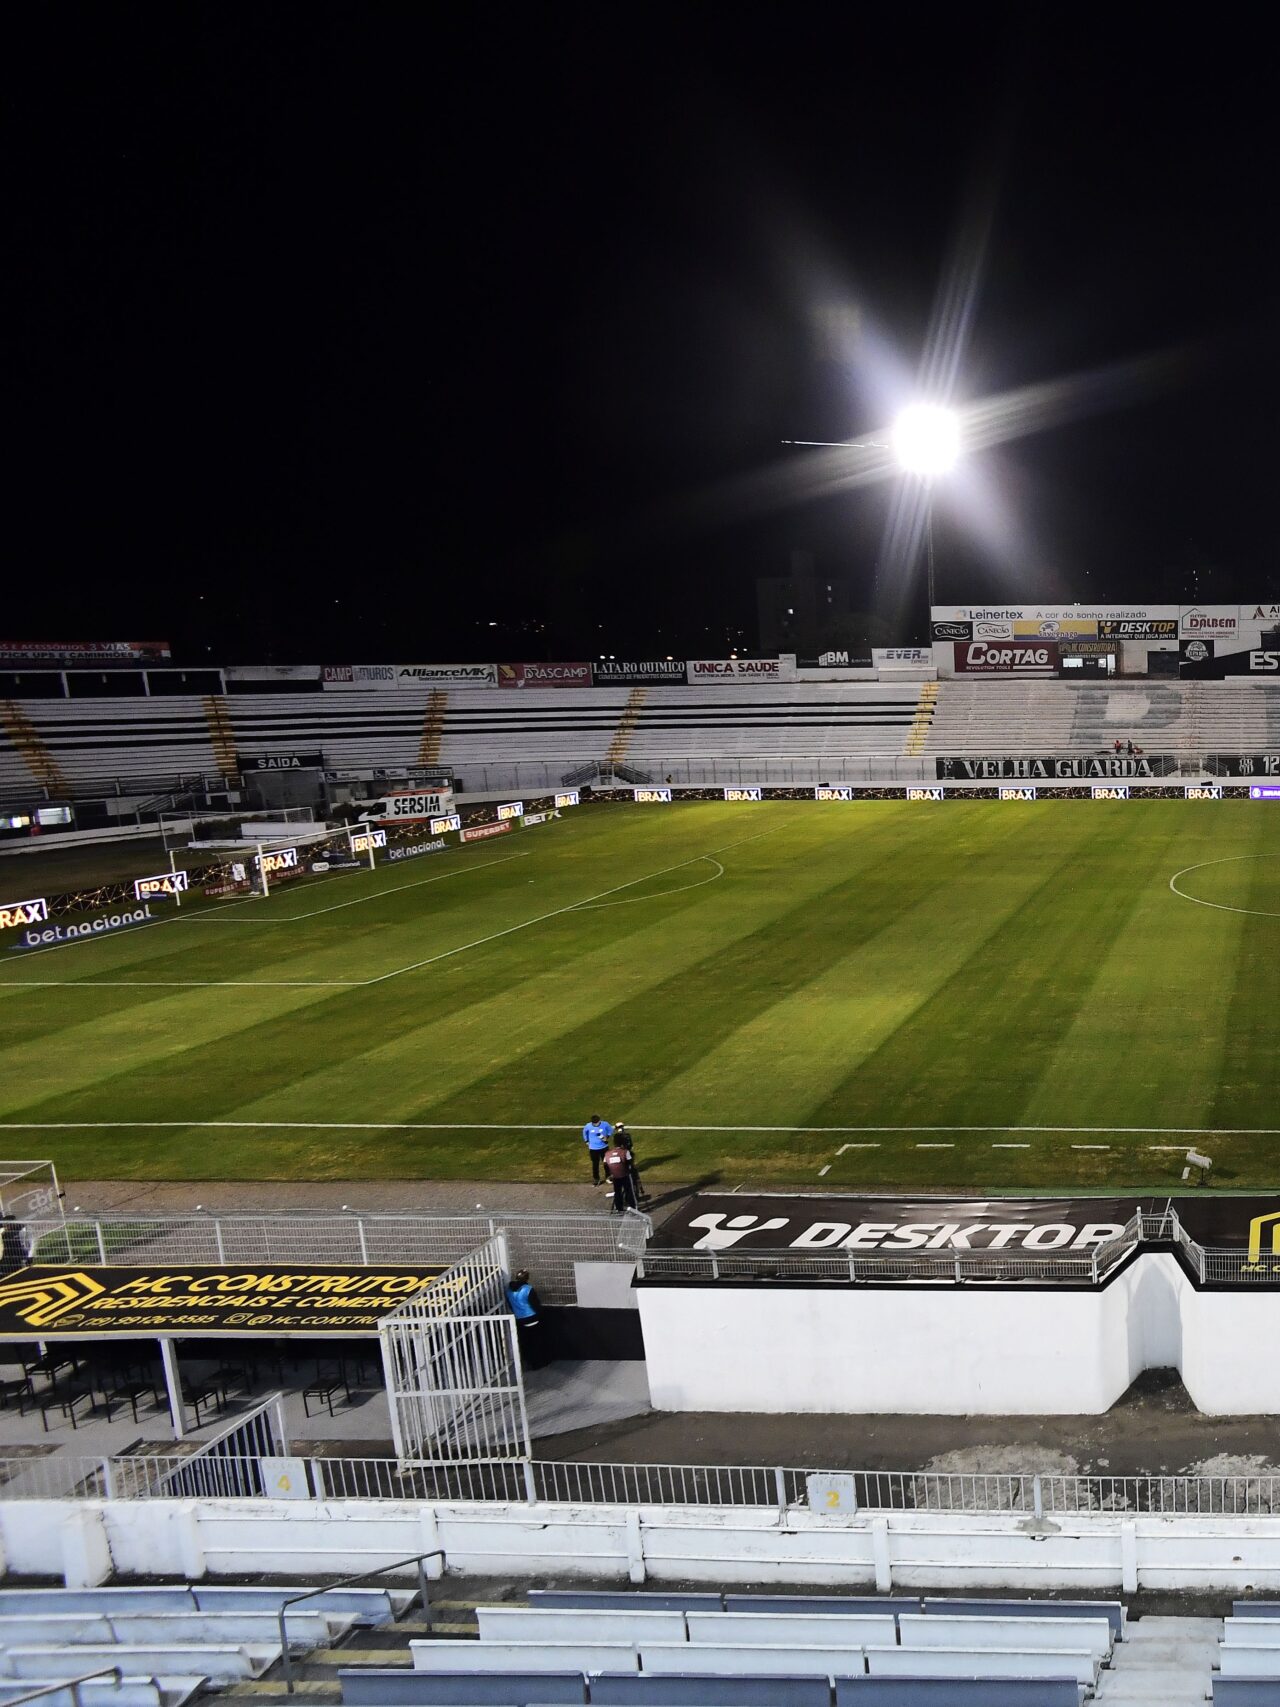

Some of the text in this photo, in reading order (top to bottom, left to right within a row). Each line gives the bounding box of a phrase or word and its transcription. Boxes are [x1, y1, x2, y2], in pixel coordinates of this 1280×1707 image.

[969, 609, 1023, 620] Leinertex
[1120, 622, 1175, 633] DESKTOP
[1190, 619, 1236, 628] DALBEM
[101, 642, 131, 651] VIAS
[828, 651, 849, 662] BM
[886, 650, 921, 659] EVER
[967, 643, 1049, 665] CORTAG
[593, 661, 685, 674] LATARO QUIMICO
[694, 660, 779, 673] ÚNICA SAÚDE
[324, 666, 352, 681] CAMP
[258, 756, 301, 769] SAÍDA
[961, 759, 1151, 778] VELHA GUARDA
[638, 791, 669, 801] BRAX
[728, 790, 758, 800] BRAX
[818, 790, 849, 800] BRAX
[909, 789, 941, 799] BRAX
[1002, 788, 1033, 799] BRAX
[1095, 788, 1126, 799] BRAX
[1188, 788, 1219, 799] BRAX
[394, 796, 440, 815] SERSIM
[557, 794, 577, 807] BRAX
[500, 804, 521, 819] BRAX
[524, 809, 562, 825] BET7K
[434, 817, 459, 833] BRAX
[466, 821, 511, 839] SUPERBET
[355, 834, 384, 852] BRAX
[389, 838, 445, 859] bet nacional
[262, 853, 294, 872] BRAX
[0, 903, 40, 929] RAX
[27, 904, 151, 946] bet nacional
[790, 1223, 1126, 1249] DESKTOP
[1241, 1265, 1267, 1273] HC
[111, 1275, 193, 1294] HC
[82, 1296, 302, 1309] RESIDENCIAIS E
[78, 1316, 116, 1327] (19)
[277, 1474, 291, 1491] 4
[826, 1490, 840, 1508] 2
